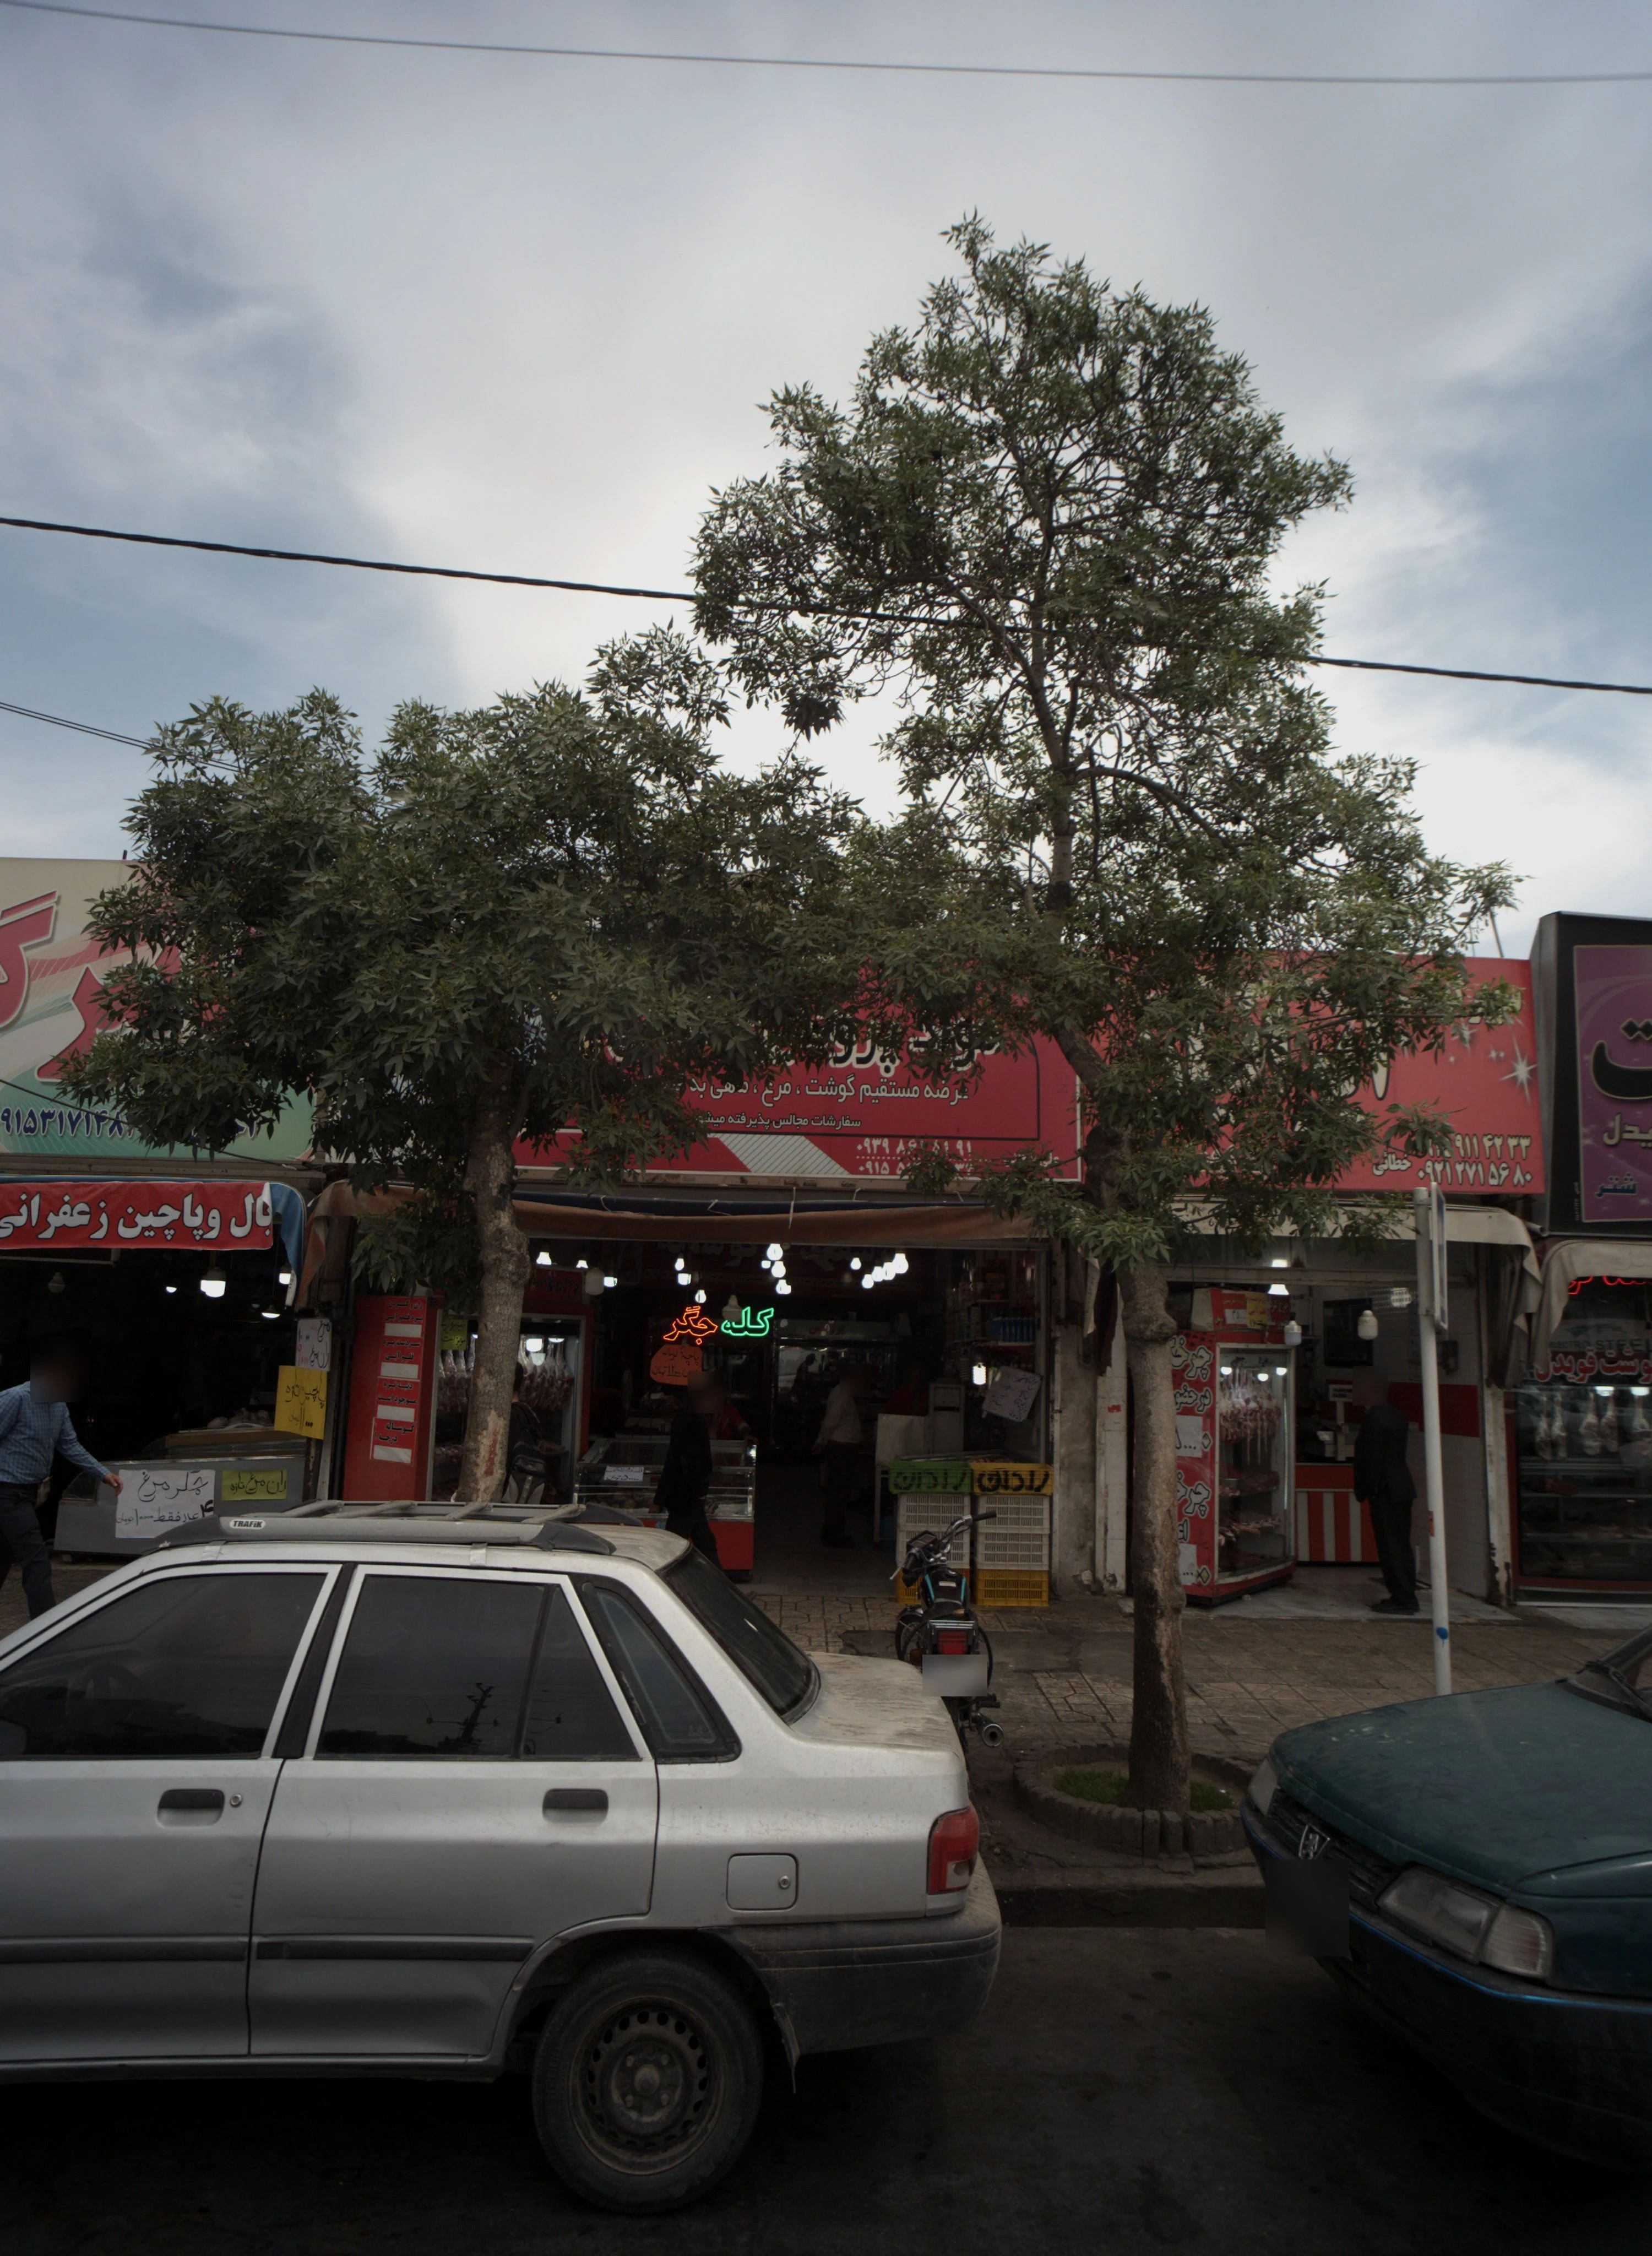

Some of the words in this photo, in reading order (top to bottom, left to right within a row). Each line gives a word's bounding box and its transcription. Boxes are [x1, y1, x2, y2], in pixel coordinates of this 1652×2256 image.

[761, 1080, 792, 1108] مرغ
[805, 1073, 856, 1103] گوشت
[860, 1077, 920, 1104] مستقیم
[1, 1107, 134, 1137] ۹۱۵۳۱۷۱۴۸
[728, 1112, 770, 1131] پذیرفته
[773, 1113, 808, 1129] مجالس
[811, 1115, 861, 1129] سفارشات
[857, 1137, 890, 1154] ۰۹۳۹
[1455, 1133, 1479, 1159] ۹۱۱
[1507, 1134, 1531, 1160] ۳۳
[858, 1160, 890, 1174] ۰۹۱۵
[1417, 1159, 1453, 1185] ۰۹۲۱
[1513, 1162, 1533, 1187] ۸۰
[1595, 1171, 1638, 1198] شتر
[0, 1192, 109, 1239] زعفرانی
[230, 1192, 273, 1239] بال
[662, 1305, 718, 1345] جگر
[720, 1306, 774, 1337] کله
[138, 1471, 170, 1503] مرغ
[153, 1505, 181, 1522] فقط
